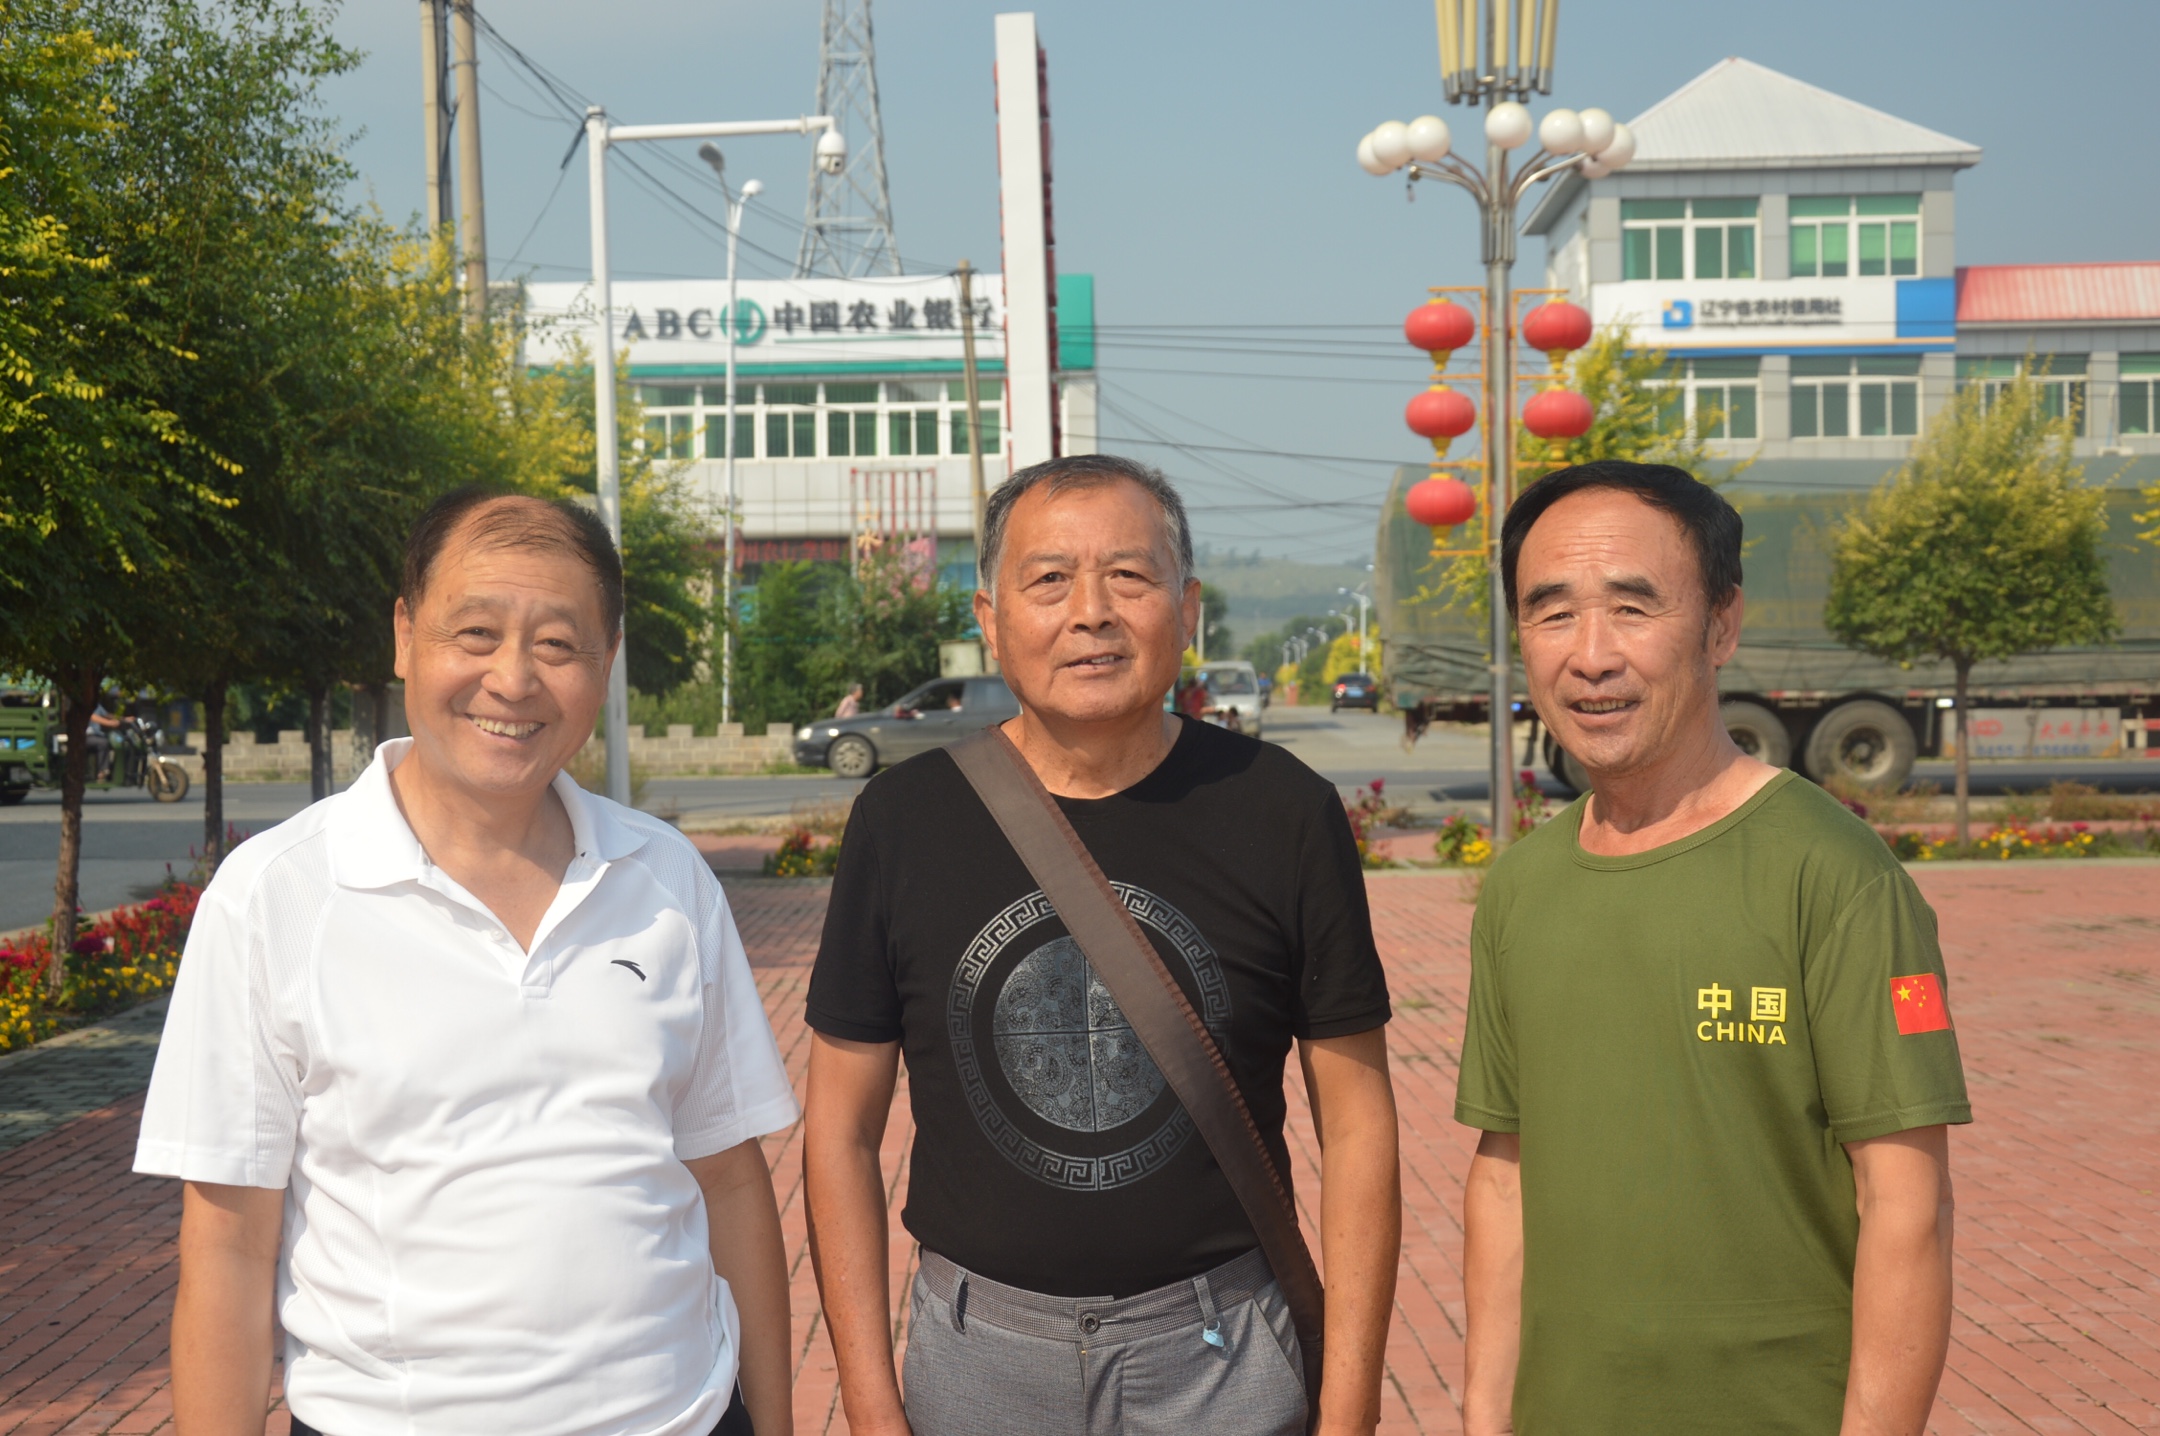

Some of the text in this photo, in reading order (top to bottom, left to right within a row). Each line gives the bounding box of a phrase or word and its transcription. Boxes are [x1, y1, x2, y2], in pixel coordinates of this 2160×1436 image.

[622, 307, 713, 340] ABC
[1698, 982, 1787, 1022] 中国
[1697, 1020, 1787, 1045] CHINA
